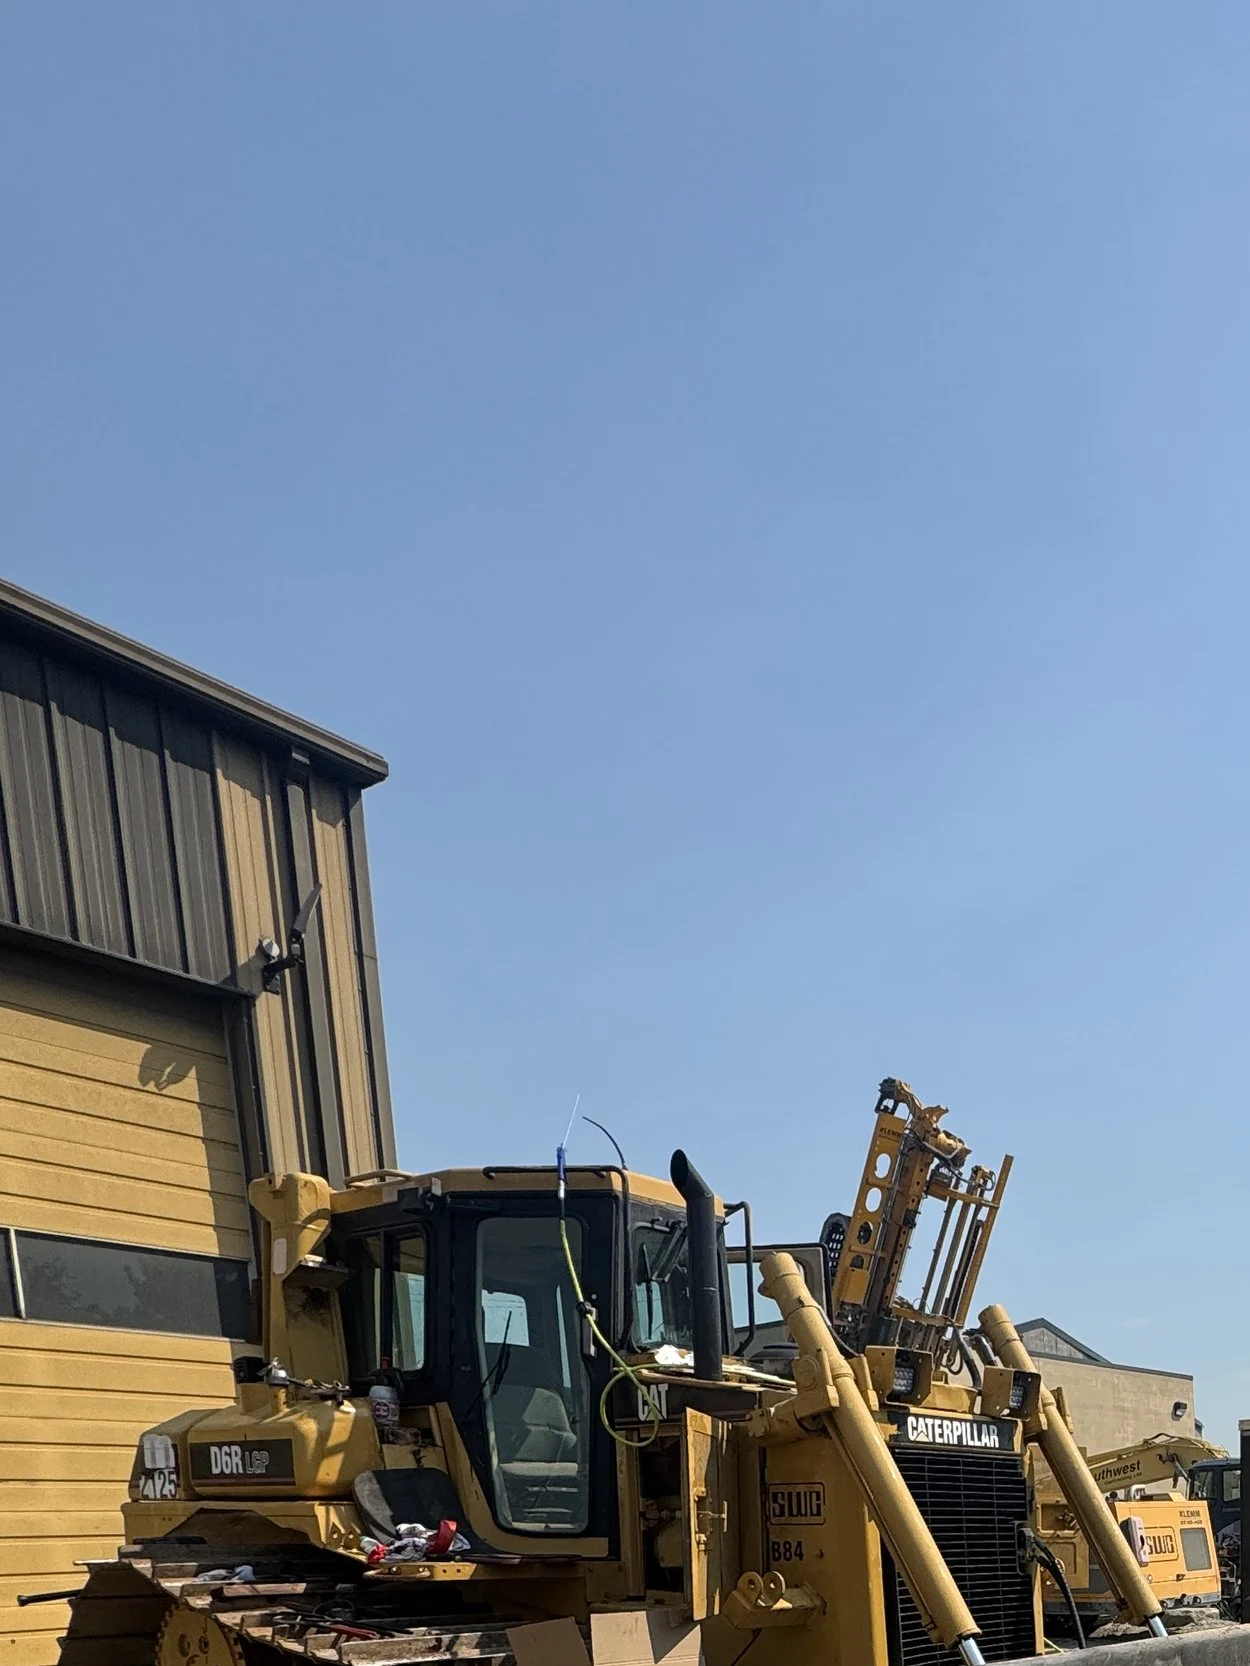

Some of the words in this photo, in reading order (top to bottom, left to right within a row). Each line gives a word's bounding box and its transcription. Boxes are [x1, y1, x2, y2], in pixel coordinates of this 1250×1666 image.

[637, 1383, 669, 1421] CAT
[907, 1416, 999, 1448] CATERPILLAR
[209, 1445, 244, 1475] D6R
[244, 1450, 270, 1474] LGP
[1094, 1460, 1141, 1482] uthwest
[772, 1491, 822, 1518] SWG
[771, 1541, 804, 1561] B84
[1145, 1535, 1175, 1555] SWG
